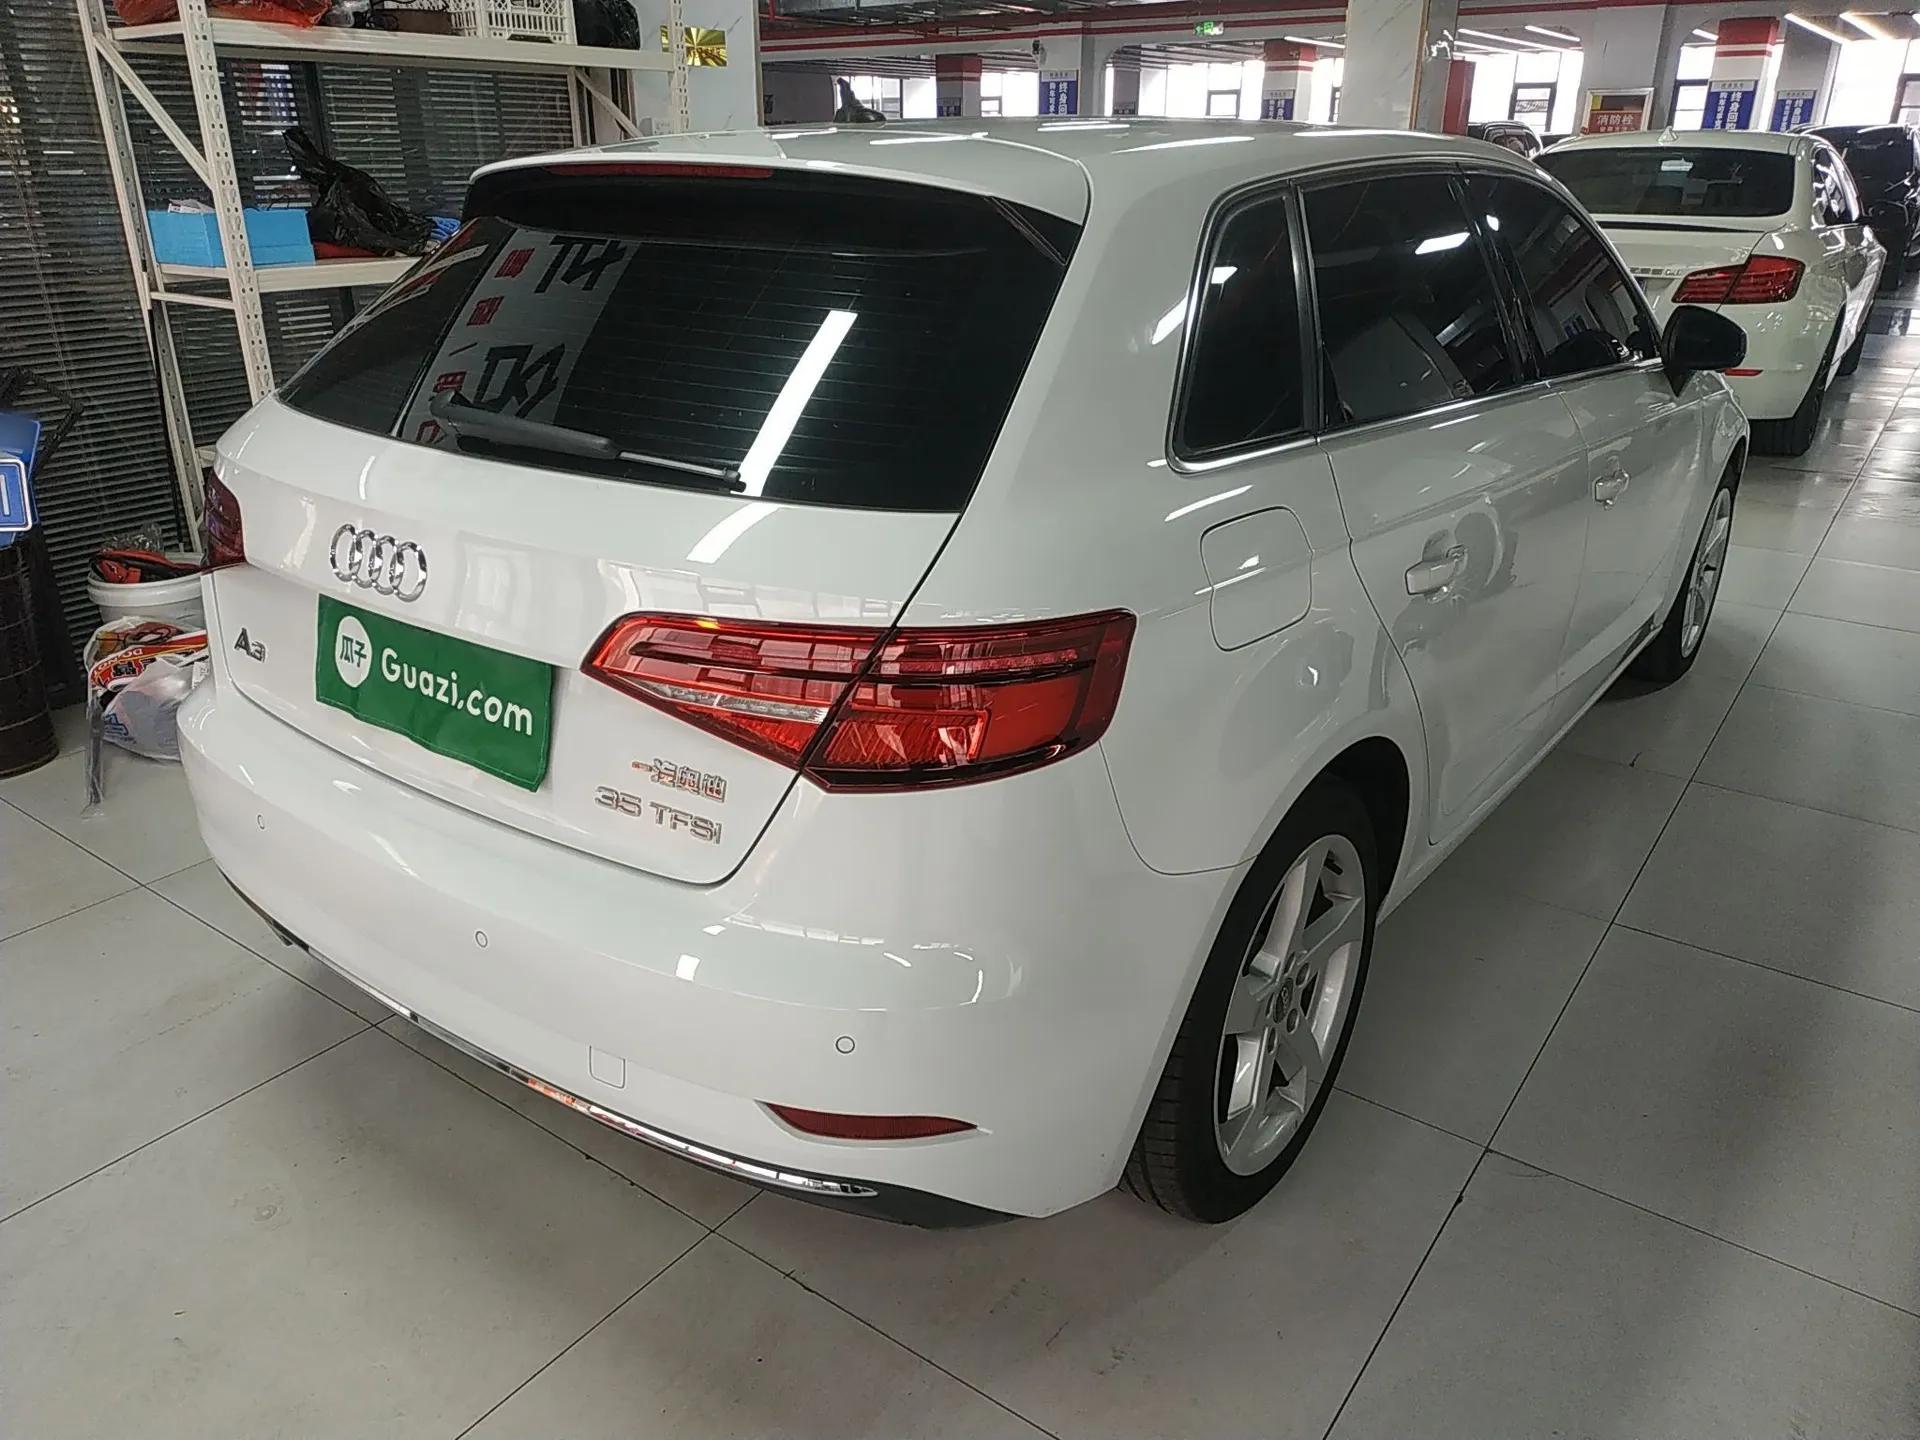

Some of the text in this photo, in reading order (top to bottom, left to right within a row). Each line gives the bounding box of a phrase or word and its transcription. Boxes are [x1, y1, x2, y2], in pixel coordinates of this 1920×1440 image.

[233, 627, 266, 663] A3
[340, 634, 368, 668] 瓜子
[381, 647, 533, 736] Guazi.com
[631, 758, 727, 803] 一汽奥迪
[595, 785, 642, 817] 35
